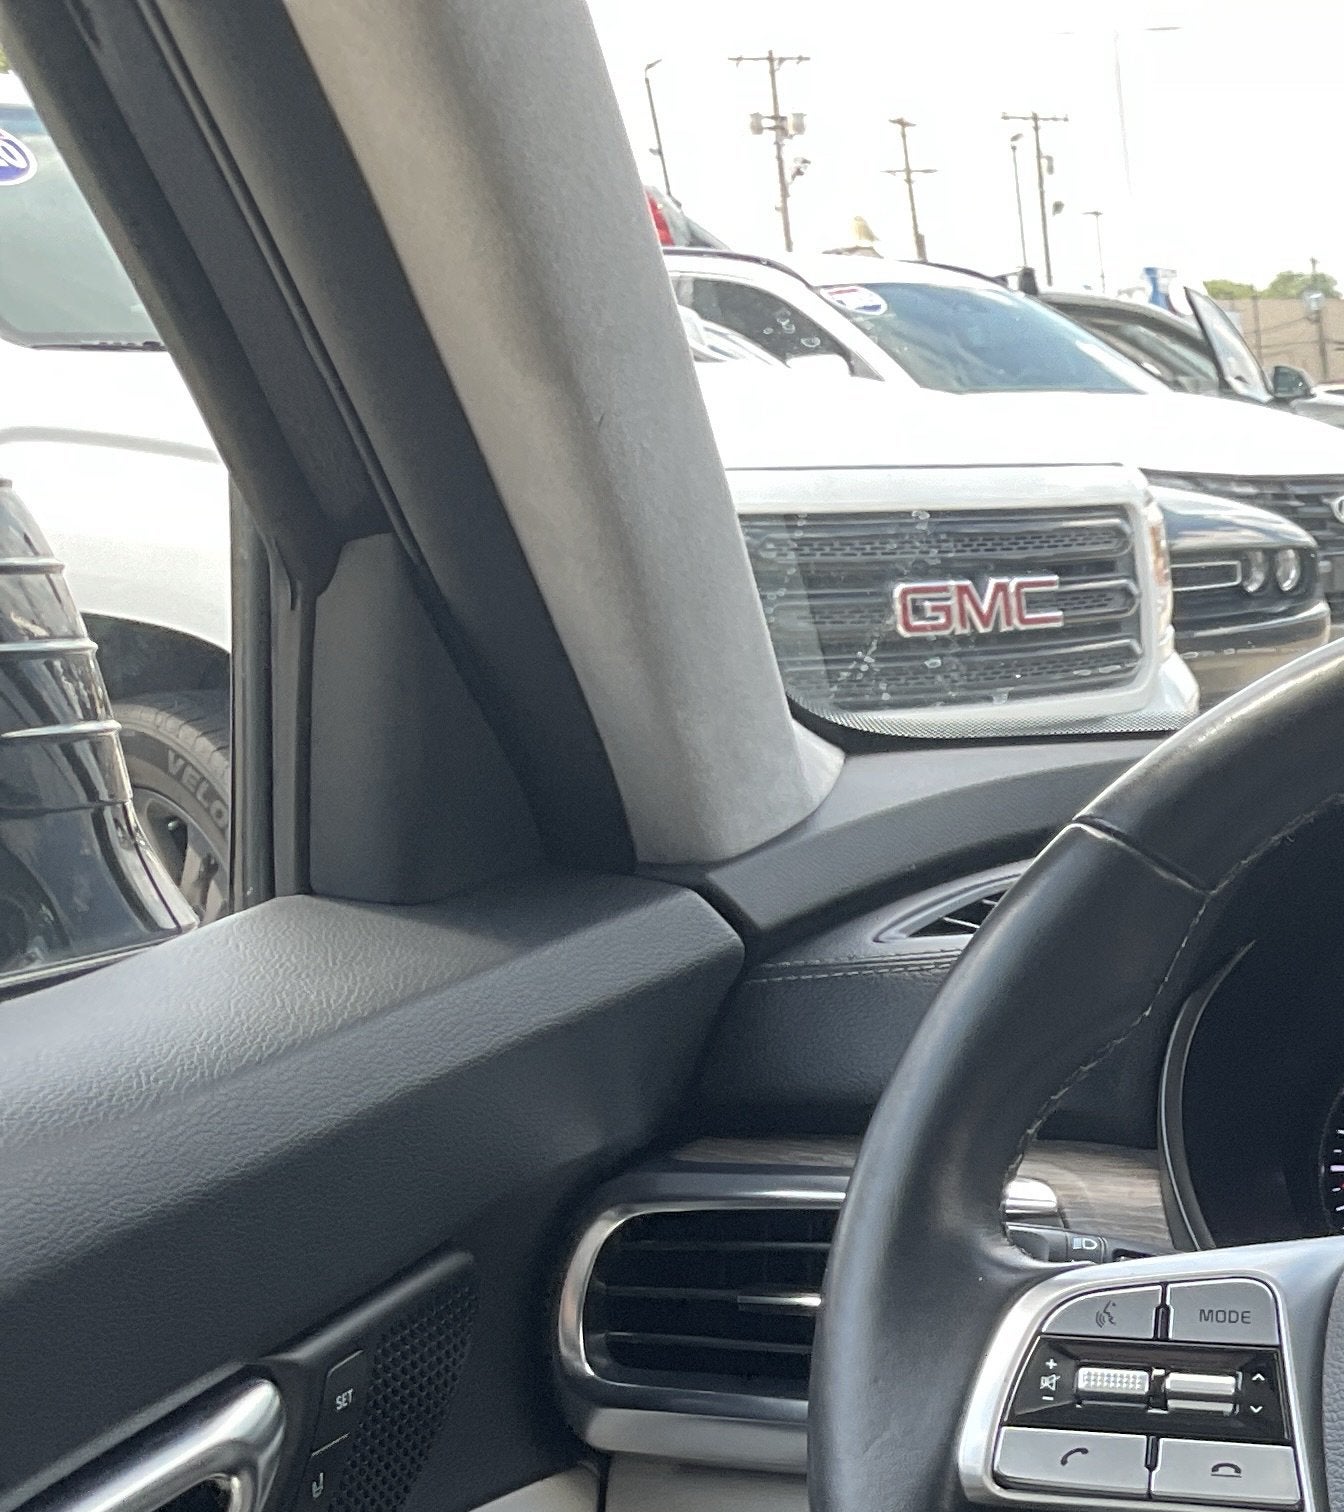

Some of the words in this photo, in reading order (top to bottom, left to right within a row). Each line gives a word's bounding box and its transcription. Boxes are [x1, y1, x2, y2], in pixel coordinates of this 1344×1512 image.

[893, 575, 1064, 638] GMC
[1199, 1309, 1251, 1324] MODE
[335, 1388, 354, 1410] SET
